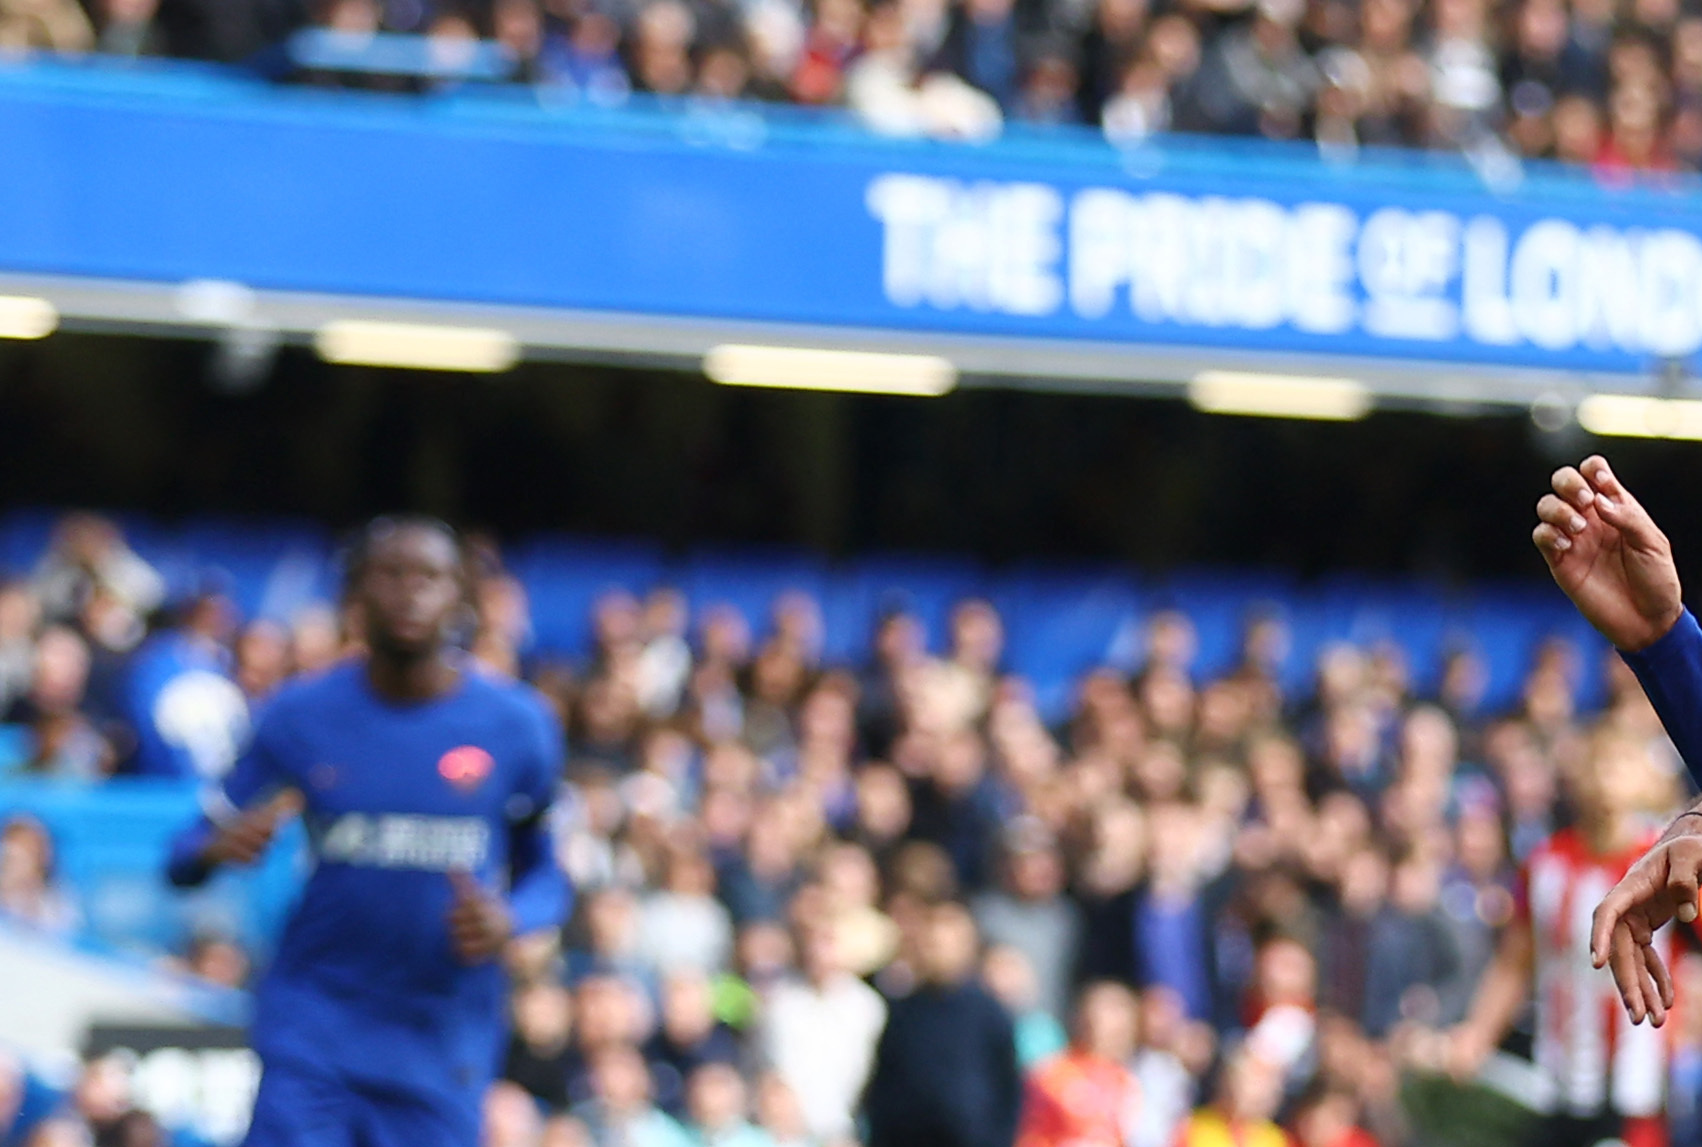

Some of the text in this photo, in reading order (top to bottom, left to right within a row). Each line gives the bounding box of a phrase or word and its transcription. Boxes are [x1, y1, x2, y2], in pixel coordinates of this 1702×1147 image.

[865, 174, 1064, 316] THE
[1068, 187, 1358, 335] PRIDE
[1359, 207, 1463, 325] OF
